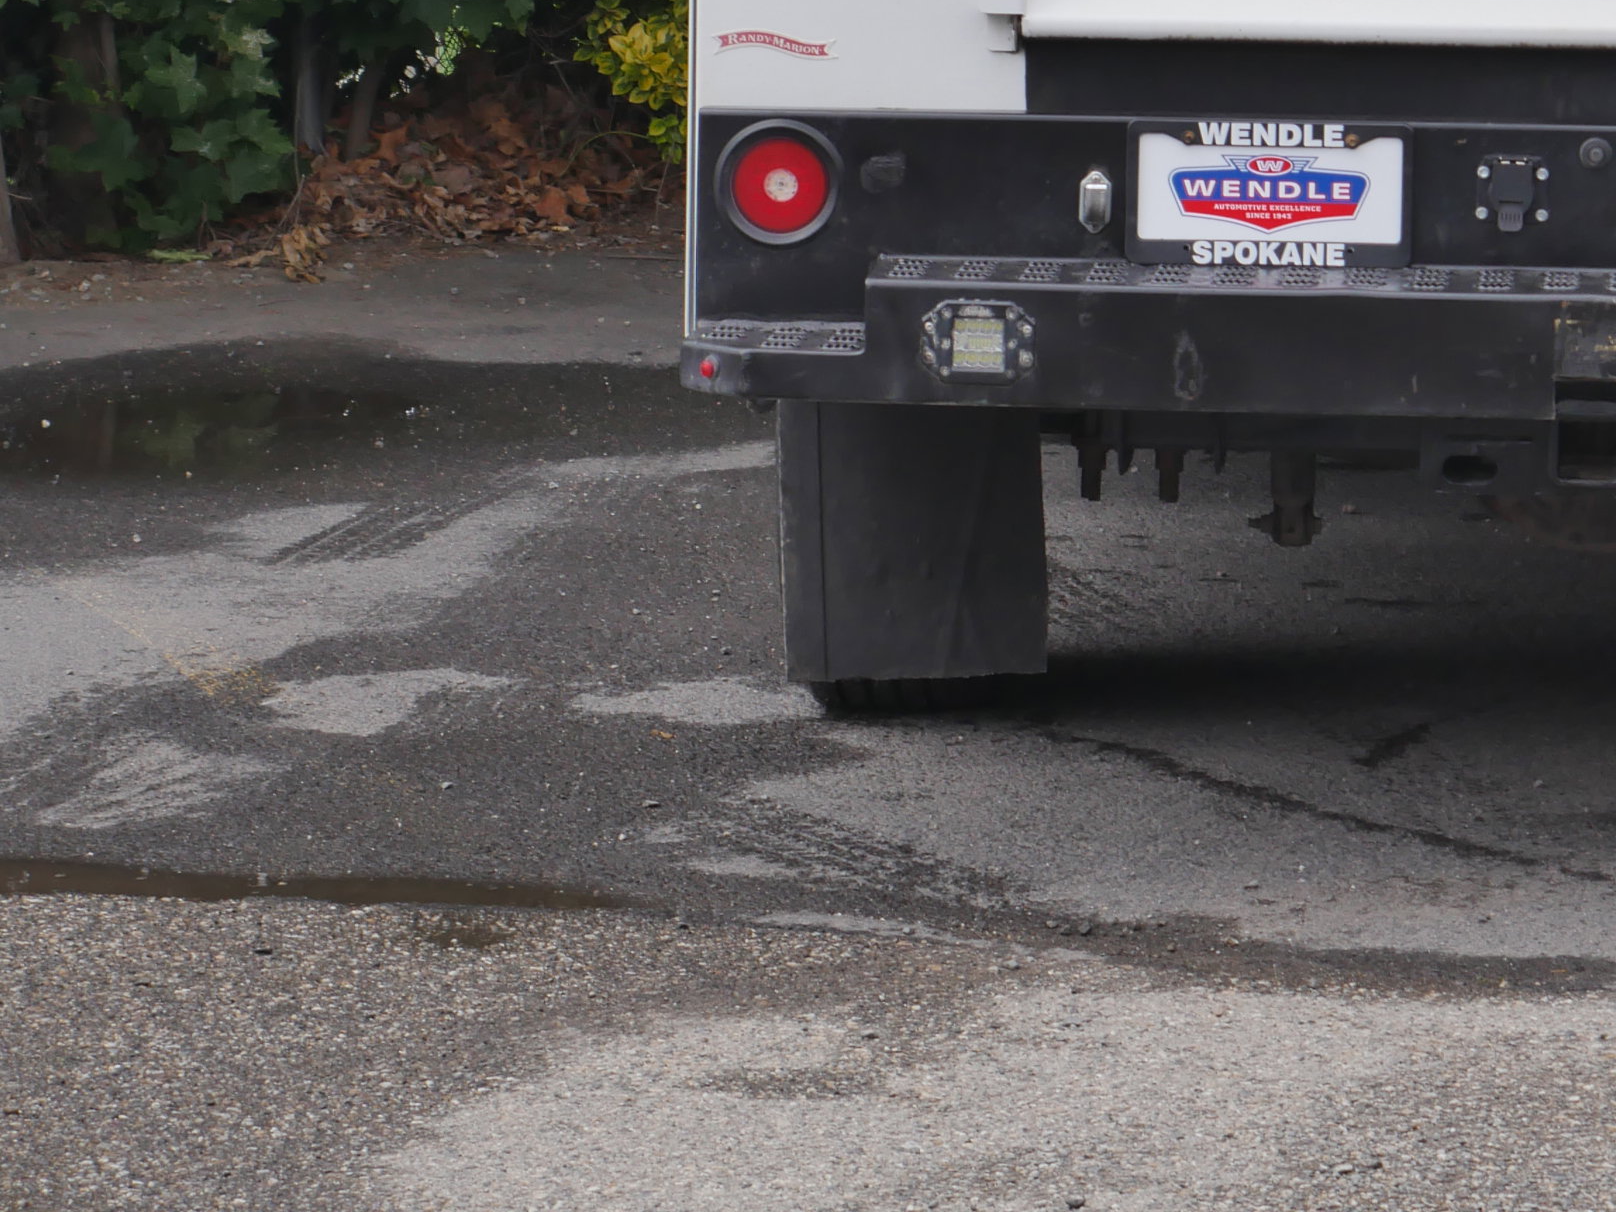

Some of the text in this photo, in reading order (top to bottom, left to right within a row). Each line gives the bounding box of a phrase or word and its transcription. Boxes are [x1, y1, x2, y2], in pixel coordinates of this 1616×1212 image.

[1199, 122, 1345, 148] WENDLE
[1183, 179, 1351, 200] WENDLE
[1214, 203, 1322, 212] AUTOMOTIVE EXCELLENCE
[1192, 241, 1346, 267] SPOKANE
